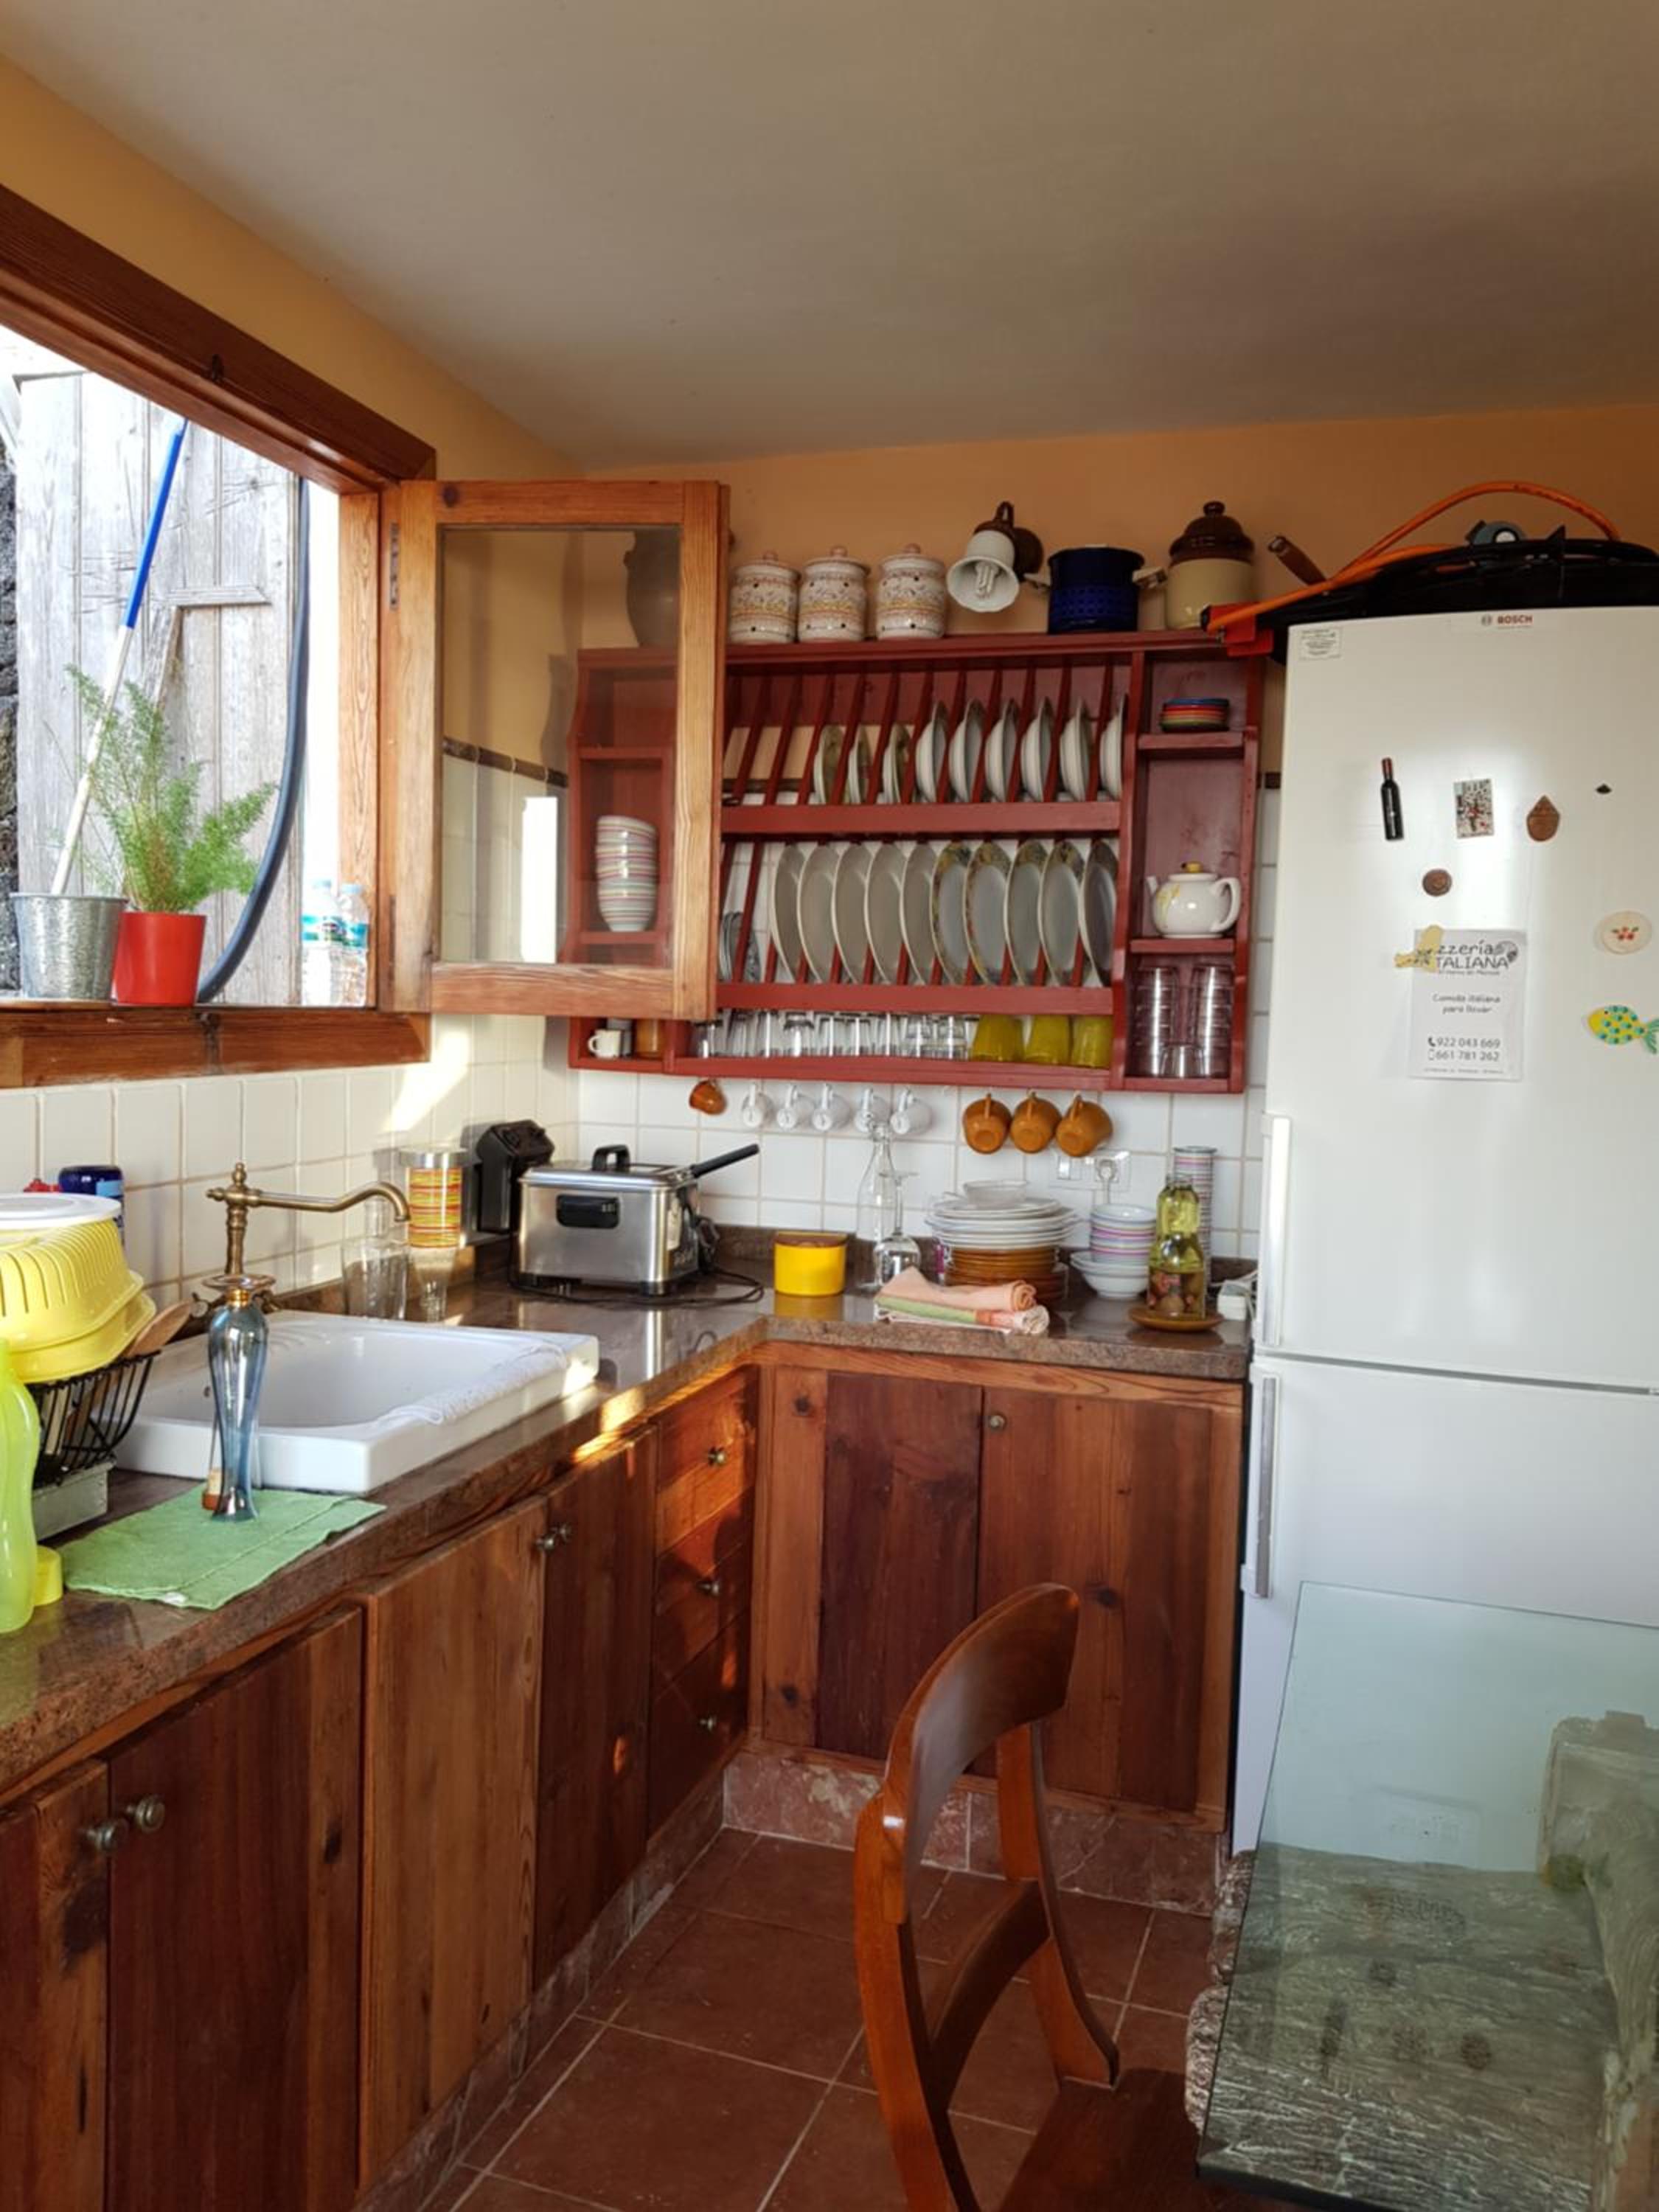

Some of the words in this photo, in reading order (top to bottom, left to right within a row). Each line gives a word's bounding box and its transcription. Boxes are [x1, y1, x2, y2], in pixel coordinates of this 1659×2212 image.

[1498, 615, 1533, 624] BOSCH
[1439, 939, 1493, 954] zzería
[1437, 956, 1509, 969] TALIANA
[1437, 1037, 1456, 1047] 922
[1458, 1037, 1478, 1047] 043
[1481, 1038, 1500, 1048] 669
[1436, 1051, 1455, 1060] 661
[1459, 1051, 1476, 1060] 781
[1480, 1051, 1500, 1061] 262
